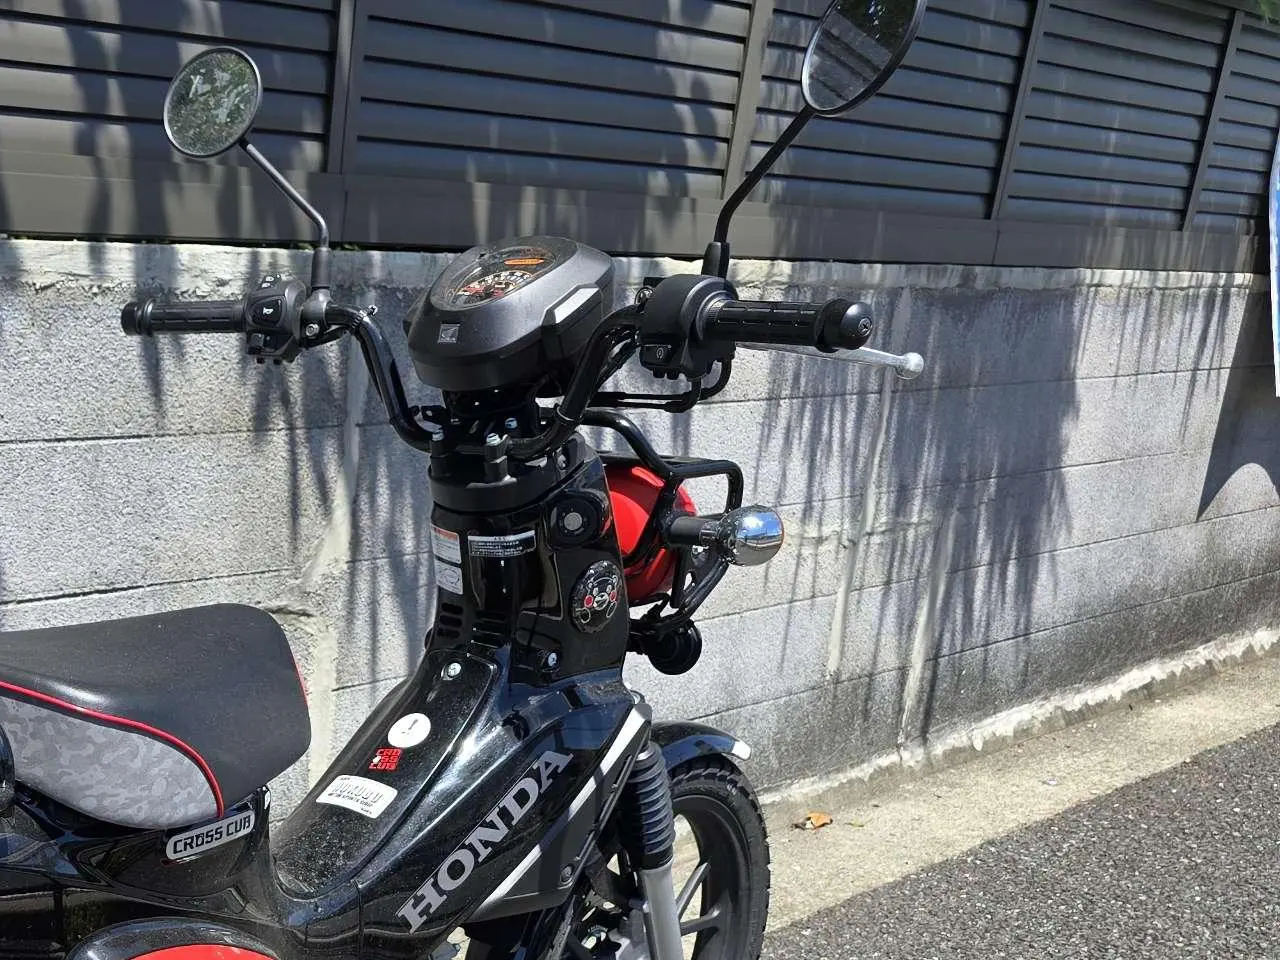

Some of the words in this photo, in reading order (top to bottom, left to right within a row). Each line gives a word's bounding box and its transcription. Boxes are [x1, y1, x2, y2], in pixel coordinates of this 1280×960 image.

[173, 826, 223, 855] CROSS
[226, 815, 251, 837] CUB
[397, 750, 573, 934] HONDA
